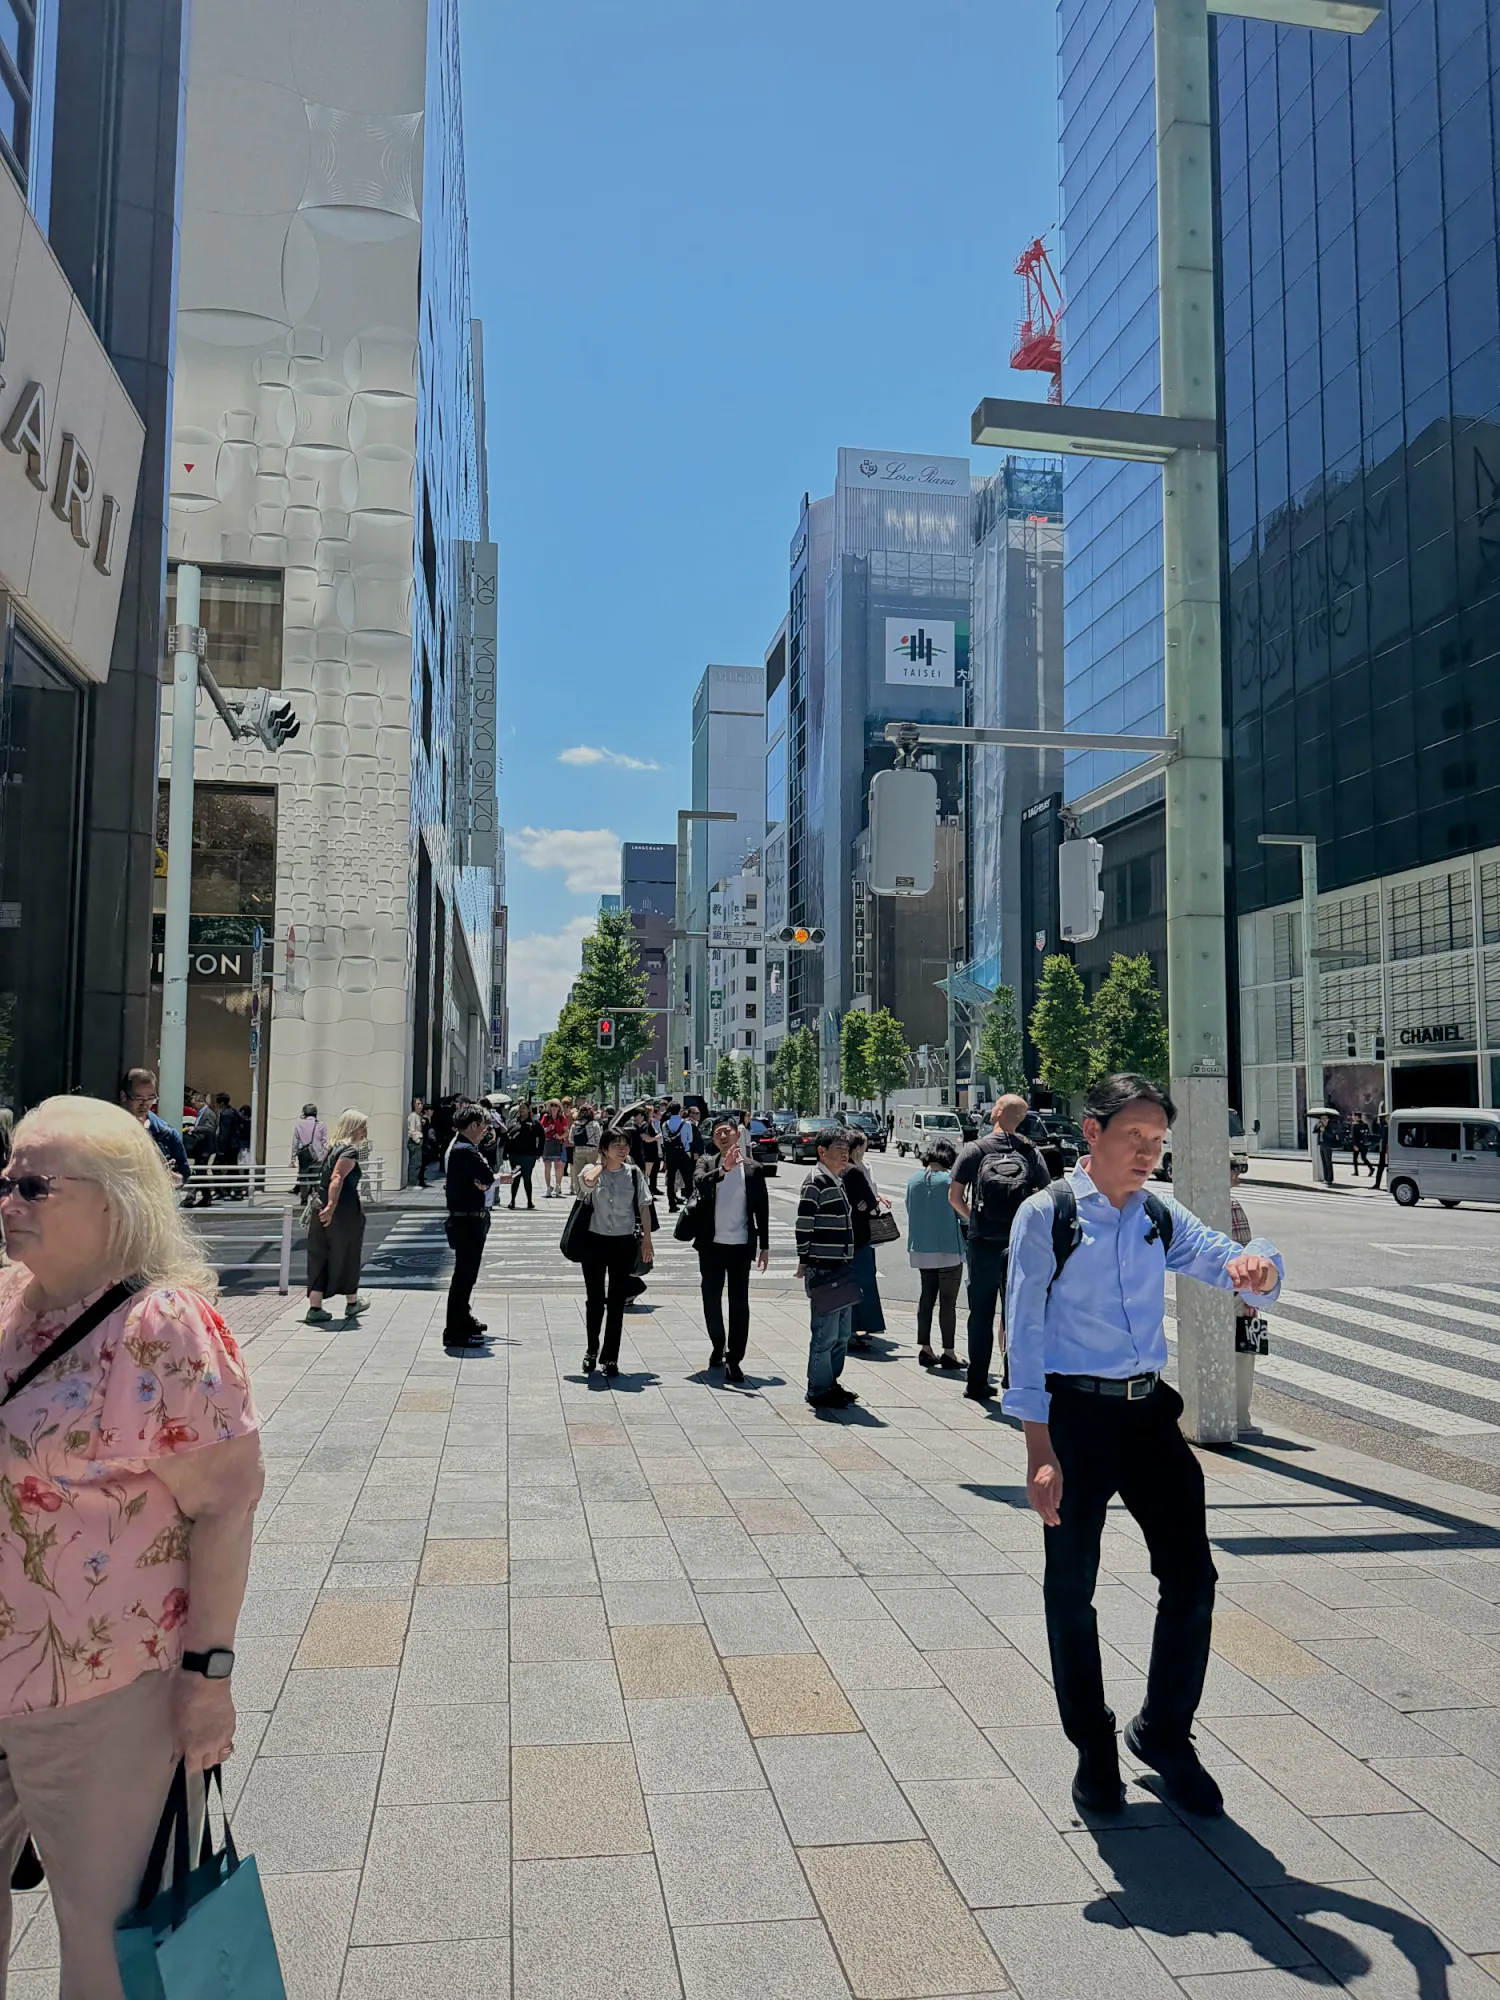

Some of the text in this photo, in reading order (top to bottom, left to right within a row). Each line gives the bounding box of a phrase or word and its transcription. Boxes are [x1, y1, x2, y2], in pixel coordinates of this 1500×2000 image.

[880, 461, 958, 487] Loro Piana
[903, 667, 942, 679] TAISEI
[956, 668, 970, 680] 大
[712, 930, 762, 941] 銀座二丁目
[711, 993, 721, 1007] 本
[1400, 1024, 1465, 1045] CHANEL
